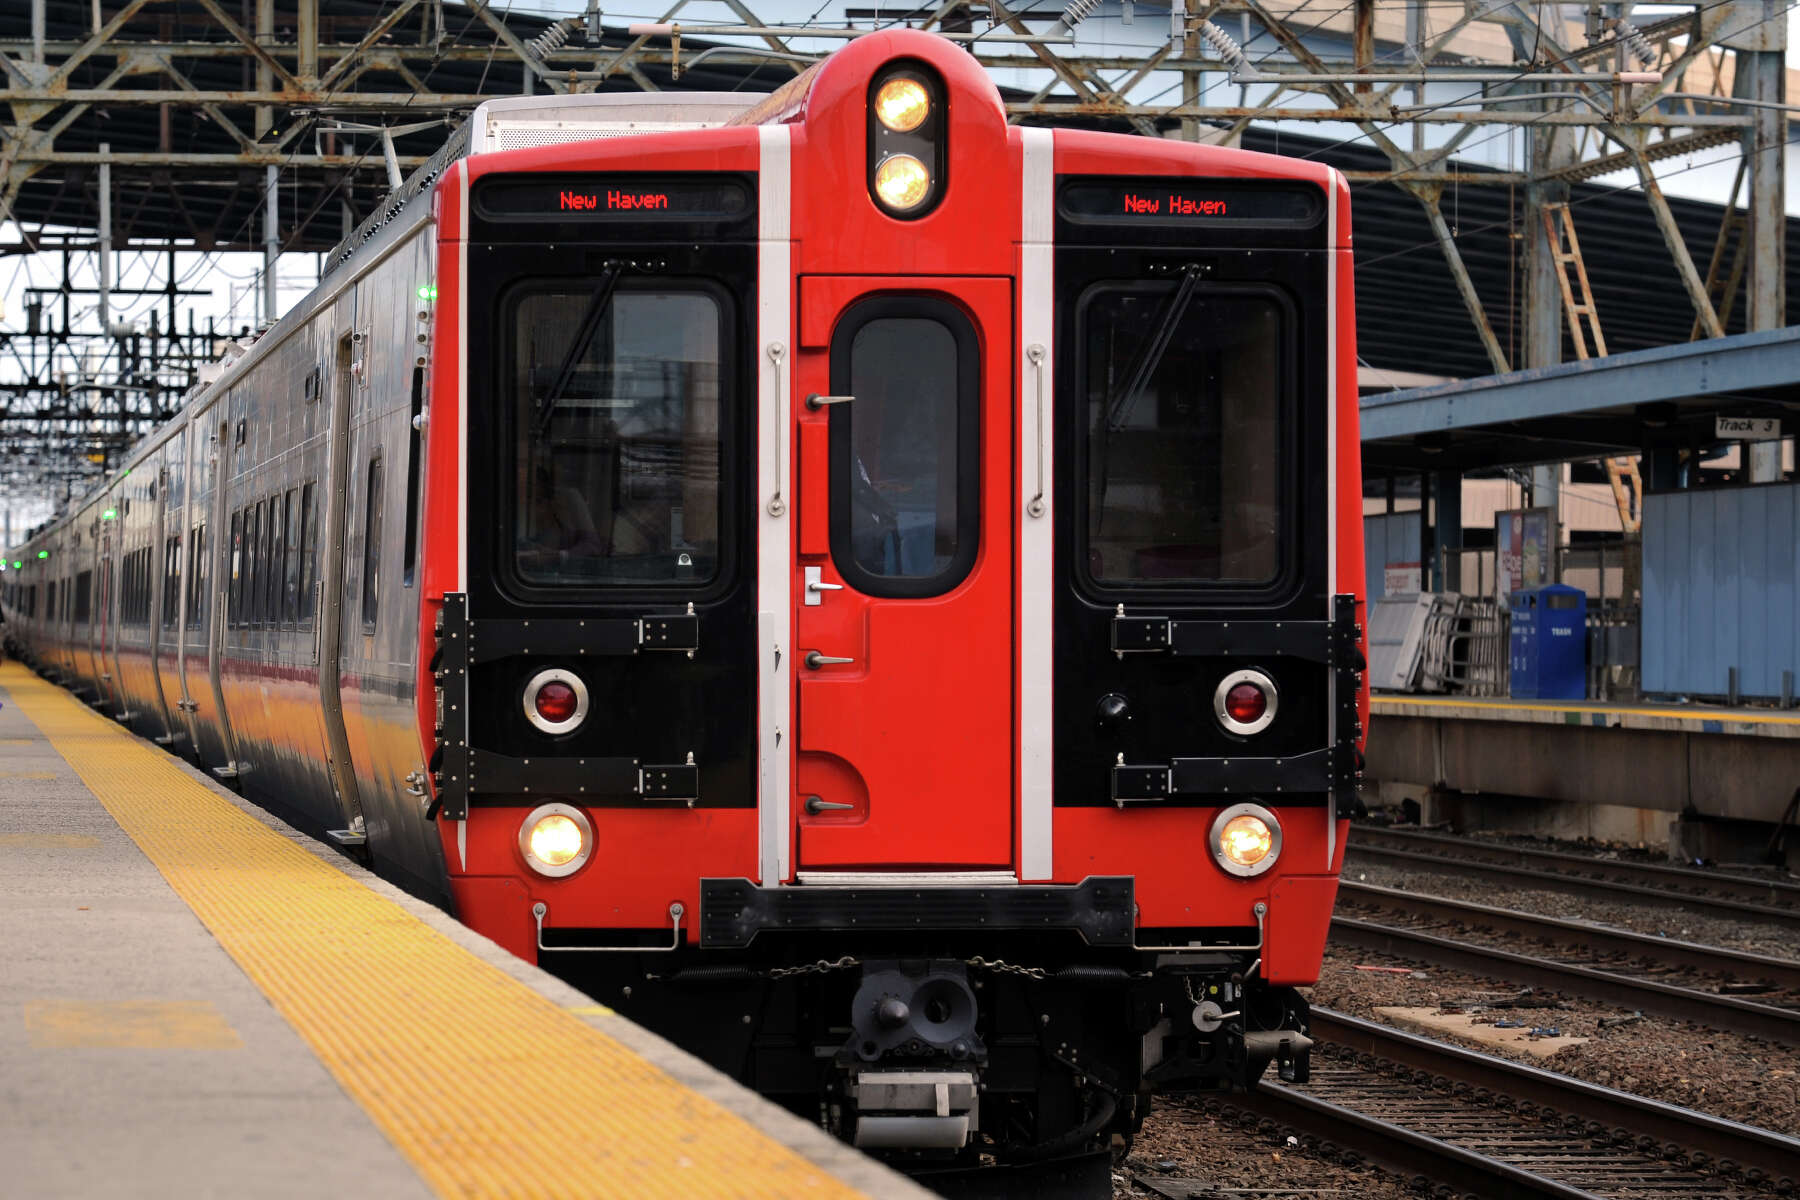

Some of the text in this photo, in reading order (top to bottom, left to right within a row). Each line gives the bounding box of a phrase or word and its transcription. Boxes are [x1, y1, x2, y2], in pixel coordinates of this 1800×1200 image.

[560, 190, 668, 210] New Haven
[1124, 194, 1227, 215] New Haven
[1719, 418, 1774, 432] Track 3
